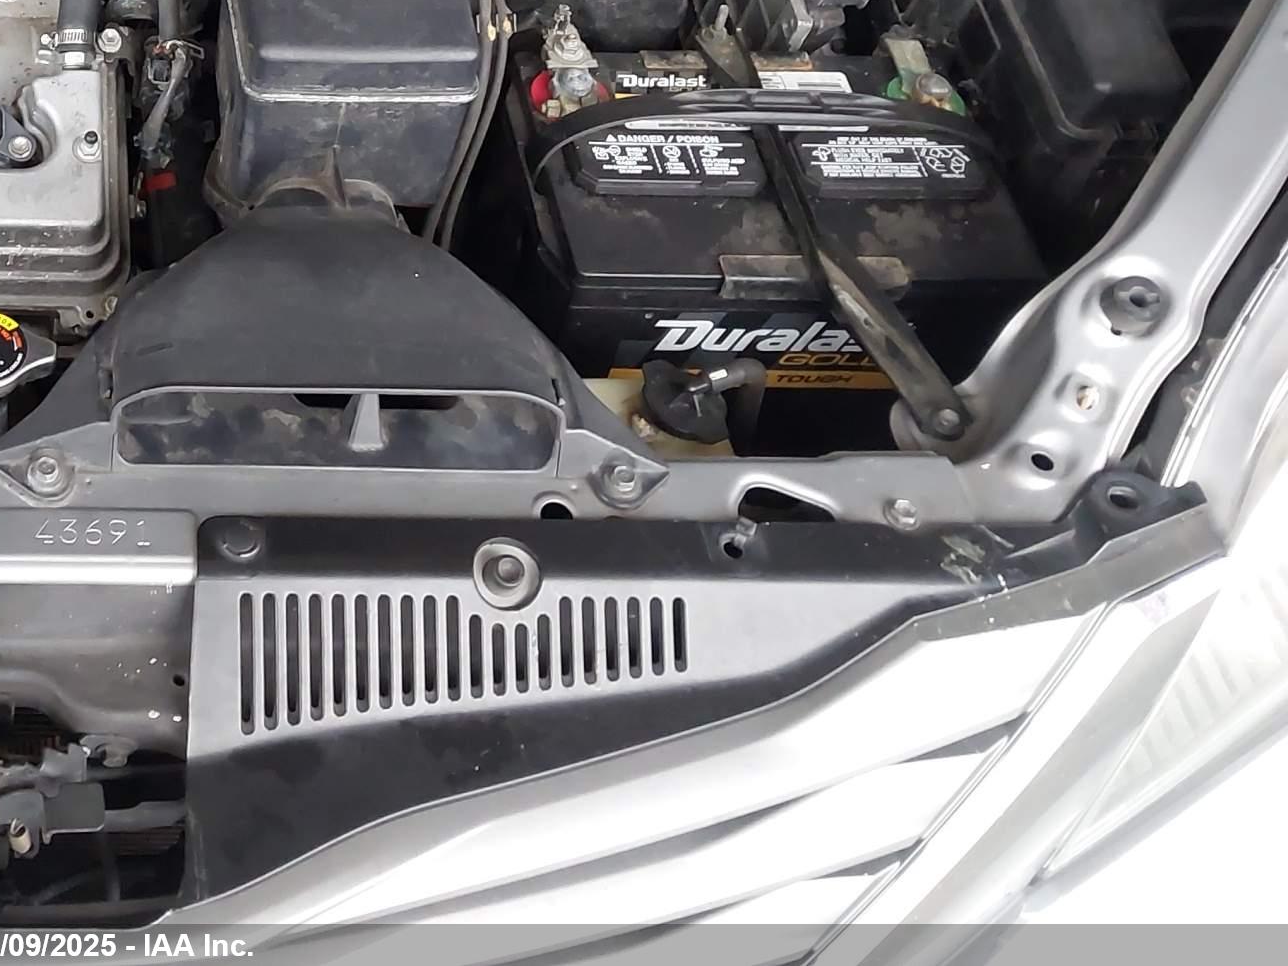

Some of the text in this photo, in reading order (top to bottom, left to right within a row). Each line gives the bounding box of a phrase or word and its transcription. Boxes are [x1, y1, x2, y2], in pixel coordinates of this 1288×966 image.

[617, 74, 707, 88] Duralast
[618, 134, 665, 143] DANGER
[676, 135, 719, 143] POISON
[35, 519, 151, 546] 43691
